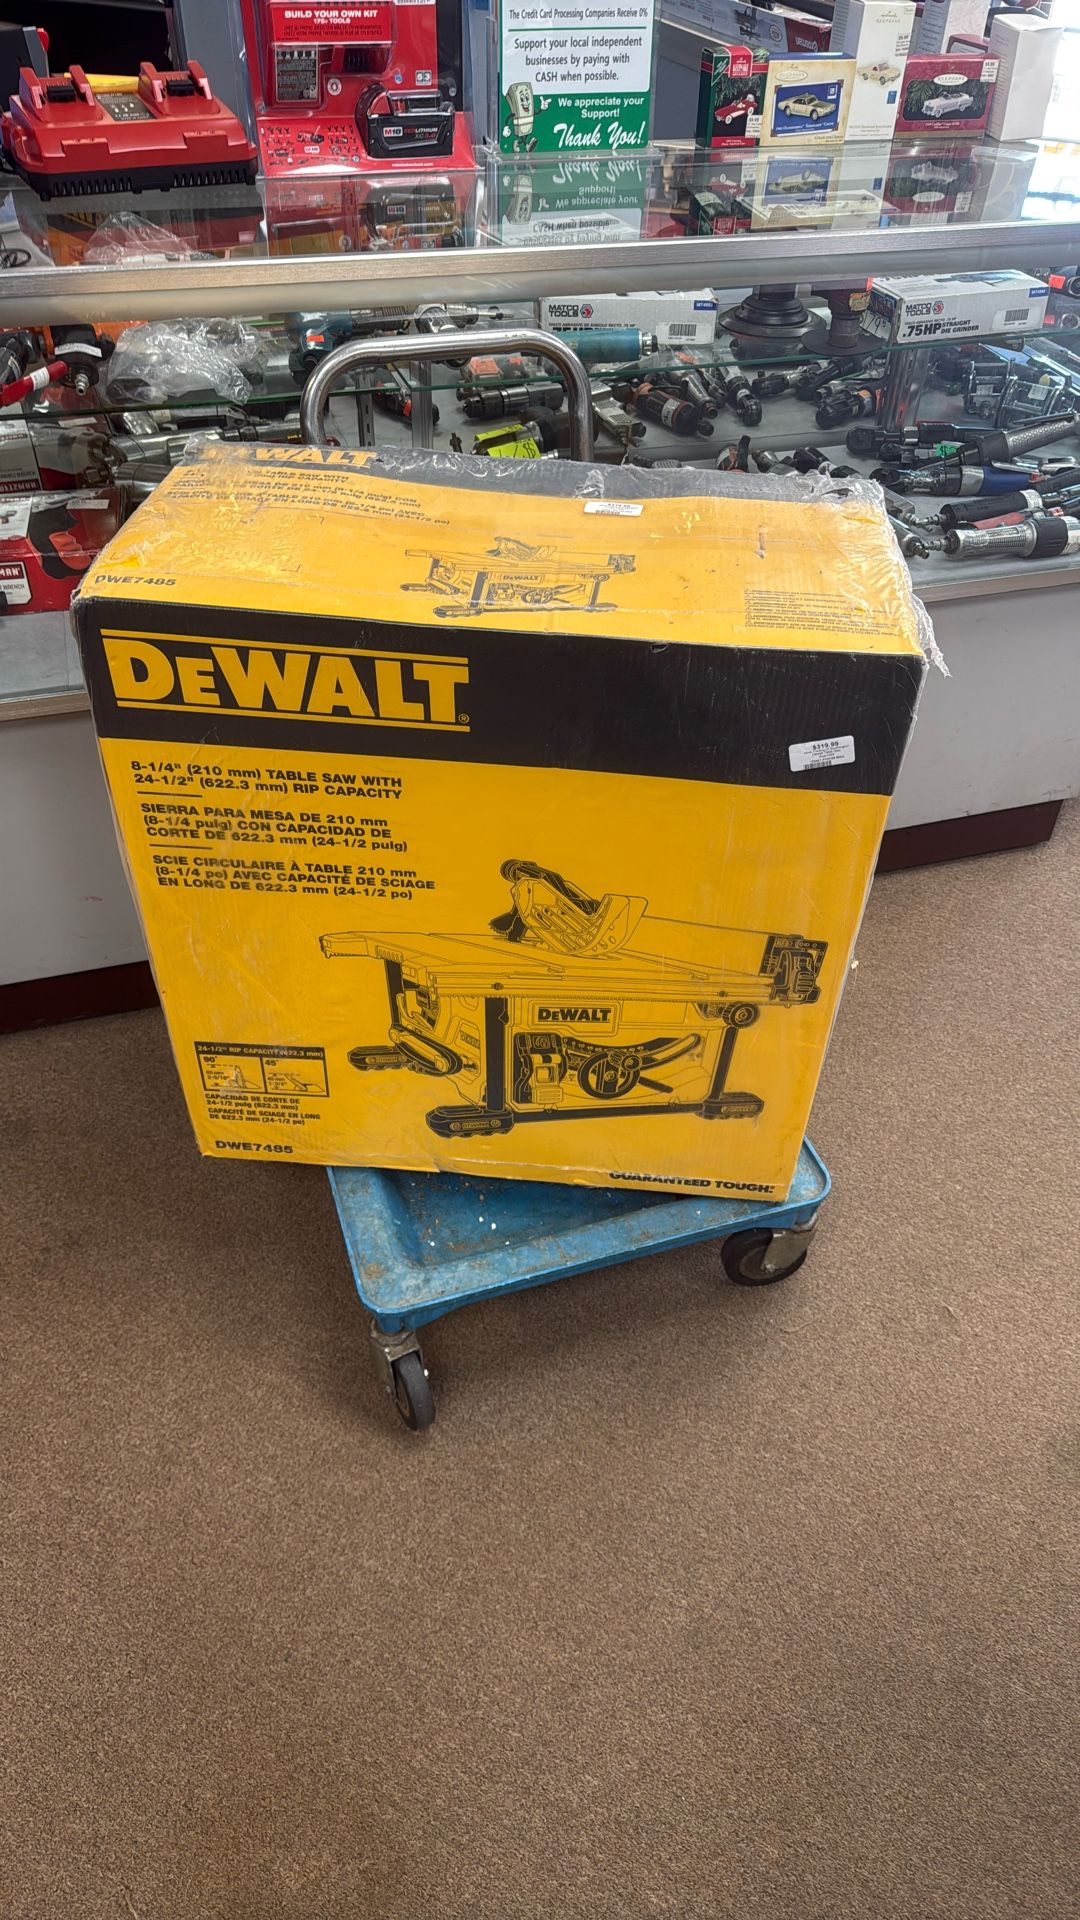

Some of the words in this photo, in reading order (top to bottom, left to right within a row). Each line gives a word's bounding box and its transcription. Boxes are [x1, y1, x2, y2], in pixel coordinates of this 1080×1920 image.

[285, 10, 312, 18] BUILD
[314, 10, 340, 18] YOUR
[342, 10, 361, 18] OWN
[364, 10, 378, 18] KIT
[509, 10, 519, 19] The
[521, 9, 538, 19] Credit
[539, 9, 553, 18] Card
[554, 8, 583, 20] Processing
[585, 8, 615, 20] Companies
[617, 8, 638, 18] Receive
[639, 7, 648, 17] 0%
[514, 38, 547, 51] Support
[549, 39, 568, 50] your
[570, 37, 589, 48] local
[591, 36, 642, 50] independent
[526, 54, 567, 66] businesses
[570, 53, 580, 67] by
[583, 54, 609, 67] paying
[612, 52, 630, 64] with
[536, 72, 557, 82] CASH
[560, 71, 582, 81] when
[584, 71, 619, 83] possible.
[558, 98, 572, 107] We
[575, 97, 621, 108] appreciate
[623, 98, 644, 108] your
[581, 109, 620, 120] Support!
[553, 123, 601, 148] Thank
[608, 121, 646, 150] You!
[549, 304, 579, 312] MATCO
[905, 303, 932, 312] MATCO
[906, 308, 931, 316] TOOLS
[902, 322, 941, 337] .75HP
[942, 320, 971, 328] STRAIGHT
[952, 325, 979, 333] GRINDER
[95, 574, 176, 586] DWE7485
[131, 761, 181, 772] 8-1/4"
[187, 764, 222, 776] (210
[228, 768, 261, 780] mm)
[265, 769, 317, 782] TABLE
[322, 773, 356, 784] SAW
[361, 775, 402, 787] WITH
[134, 774, 193, 786] 24-1/2"
[200, 777, 249, 790] (622.3
[255, 782, 288, 794] mm)
[293, 783, 319, 794] RIP
[324, 785, 402, 799] CAPACITY
[141, 803, 199, 815] SIERRA
[204, 807, 245, 818] PARA
[250, 810, 294, 821] MESA
[300, 812, 321, 822] DE
[326, 814, 355, 825] 210
[360, 818, 388, 826] mm
[144, 815, 190, 827] (8-1/4
[195, 819, 231, 831] pulg)
[238, 821, 271, 831] CON
[276, 823, 365, 837] CAPACIDAD
[371, 828, 391, 838] DE
[146, 827, 200, 839] CORTE
[205, 830, 226, 840] DE
[232, 832, 274, 843] 622.3
[280, 837, 307, 845] mm
[312, 836, 366, 848] (24-1/2
[372, 840, 408, 852] pulg)
[153, 855, 189, 865] SCIE
[193, 857, 285, 870] CIRCULAIRE
[290, 860, 300, 871] À
[305, 863, 353, 874] TABLE
[358, 866, 385, 876] 210
[390, 869, 416, 878] mm
[156, 866, 200, 877] (8-1/4
[205, 870, 228, 880] po)
[233, 870, 272, 880] AVEC
[277, 873, 351, 885] CAPACITÉ
[356, 877, 376, 886] DE
[380, 878, 435, 889] SCIAGE
[158, 877, 179, 886] EN
[184, 878, 225, 889] LONG
[230, 881, 251, 890] DE
[256, 883, 297, 892] 622.3
[302, 886, 328, 894] mm
[334, 886, 386, 897] (24-1/2
[391, 890, 412, 900] po)
[538, 1008, 611, 1021] DEWALT
[205, 1094, 248, 1102] CAPACIDAD
[263, 1096, 287, 1104] CORTE
[208, 1107, 245, 1116] CAPACITÉ
[254, 1102, 278, 1110] (622.3
[262, 1117, 291, 1125] (24-1/2
[215, 1140, 293, 1154] DWE7485
[609, 1172, 711, 1188] GUARANTEED
